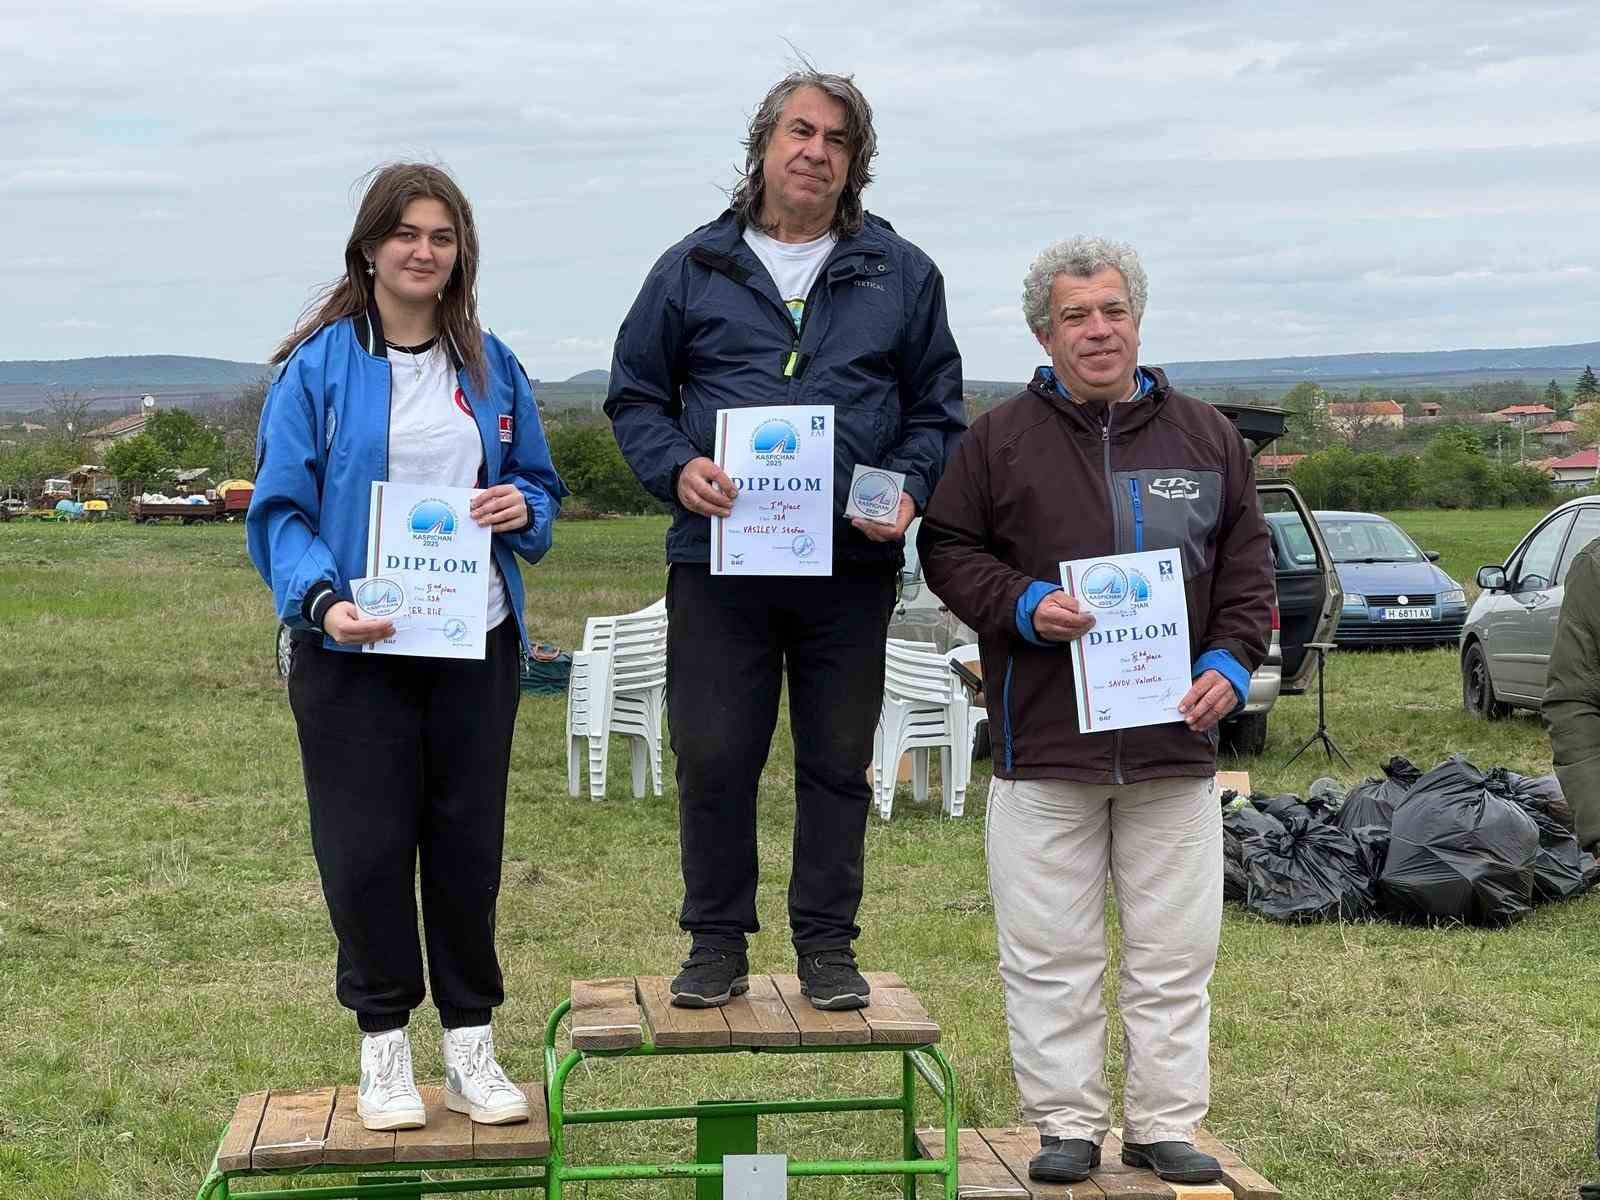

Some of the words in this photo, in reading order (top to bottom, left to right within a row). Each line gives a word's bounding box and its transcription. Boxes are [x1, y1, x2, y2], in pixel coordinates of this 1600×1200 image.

[731, 477, 823, 492] DIPLOM
[412, 534, 452, 542] KASPICHAN
[386, 555, 479, 574] DIPLOM
[1089, 623, 1178, 645] DIPLOM
